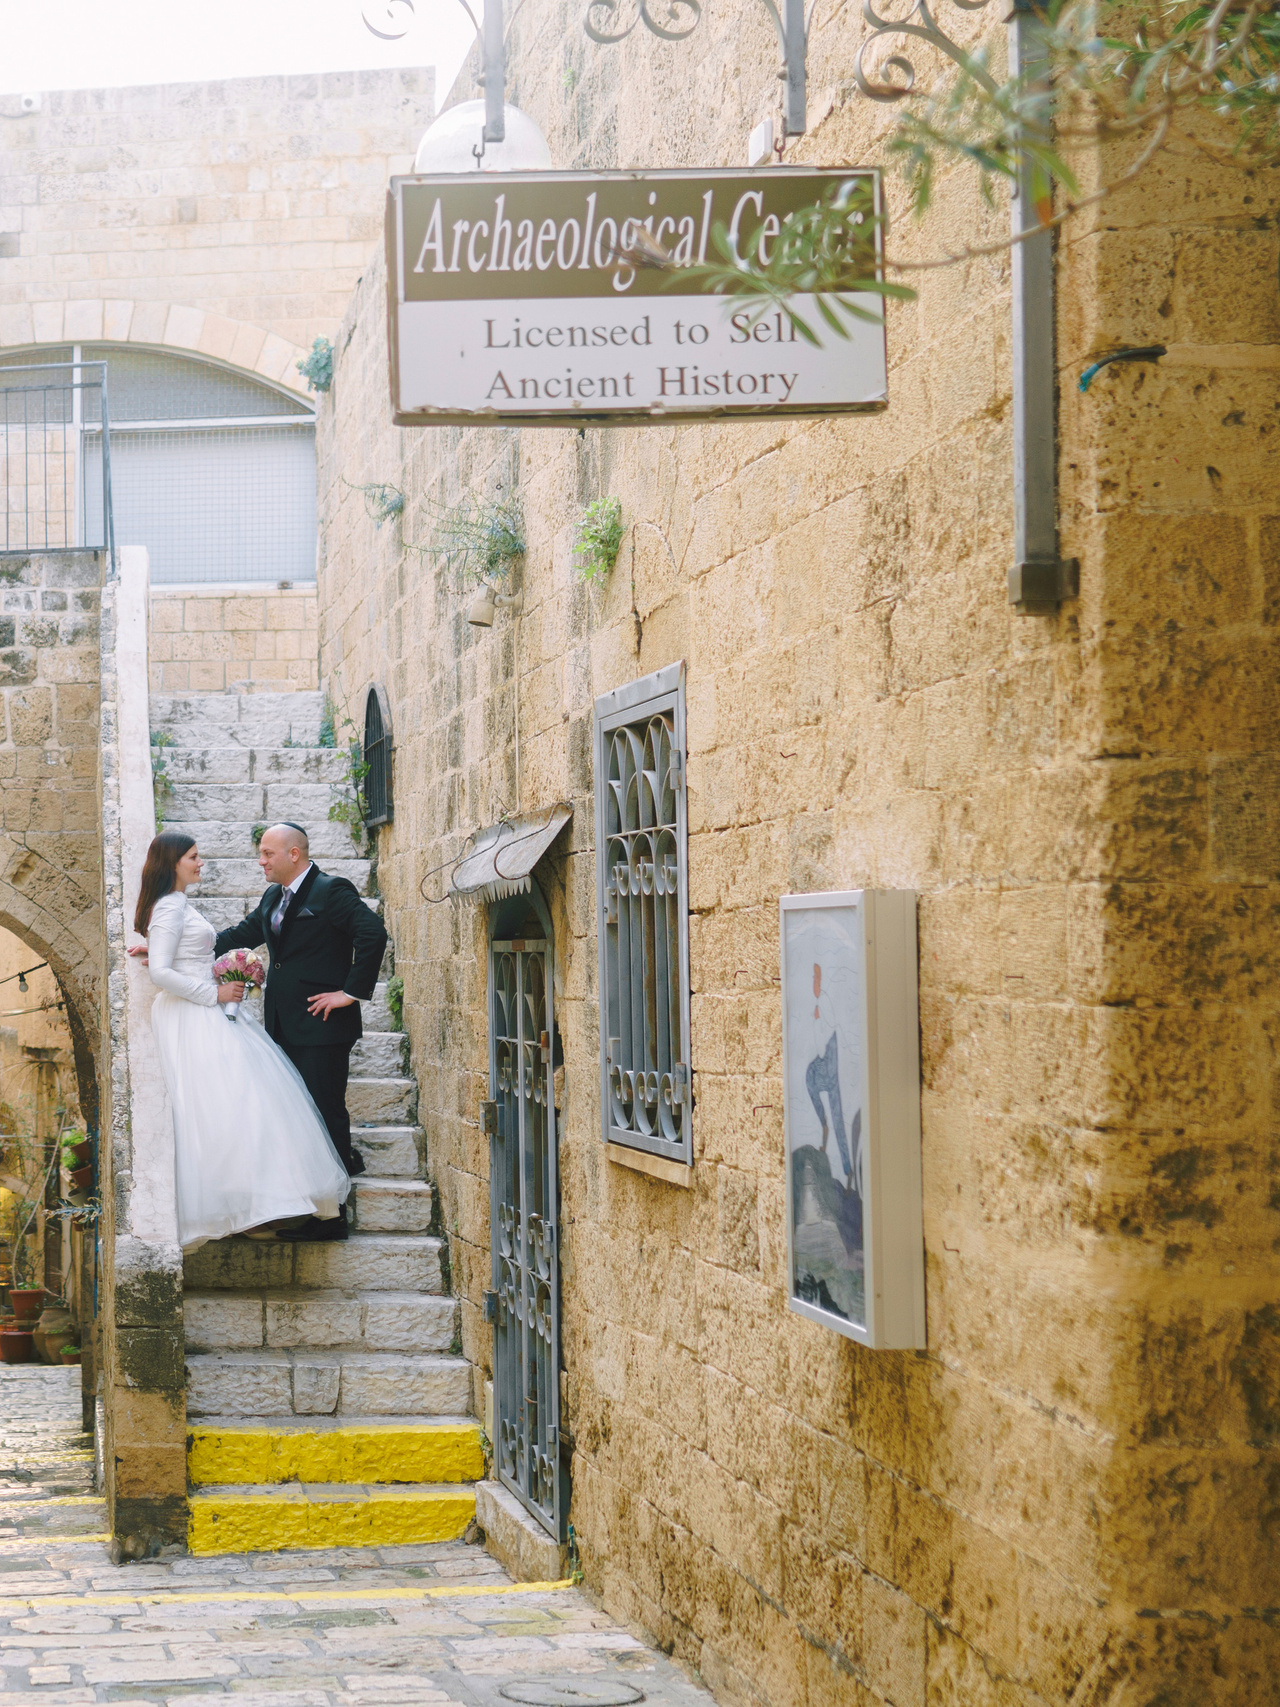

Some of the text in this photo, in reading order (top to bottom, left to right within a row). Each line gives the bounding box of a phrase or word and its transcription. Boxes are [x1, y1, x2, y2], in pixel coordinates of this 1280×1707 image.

[413, 190, 712, 293] Archaeological
[484, 313, 798, 349] Licensed to Sell
[486, 364, 799, 403] Ancient History
